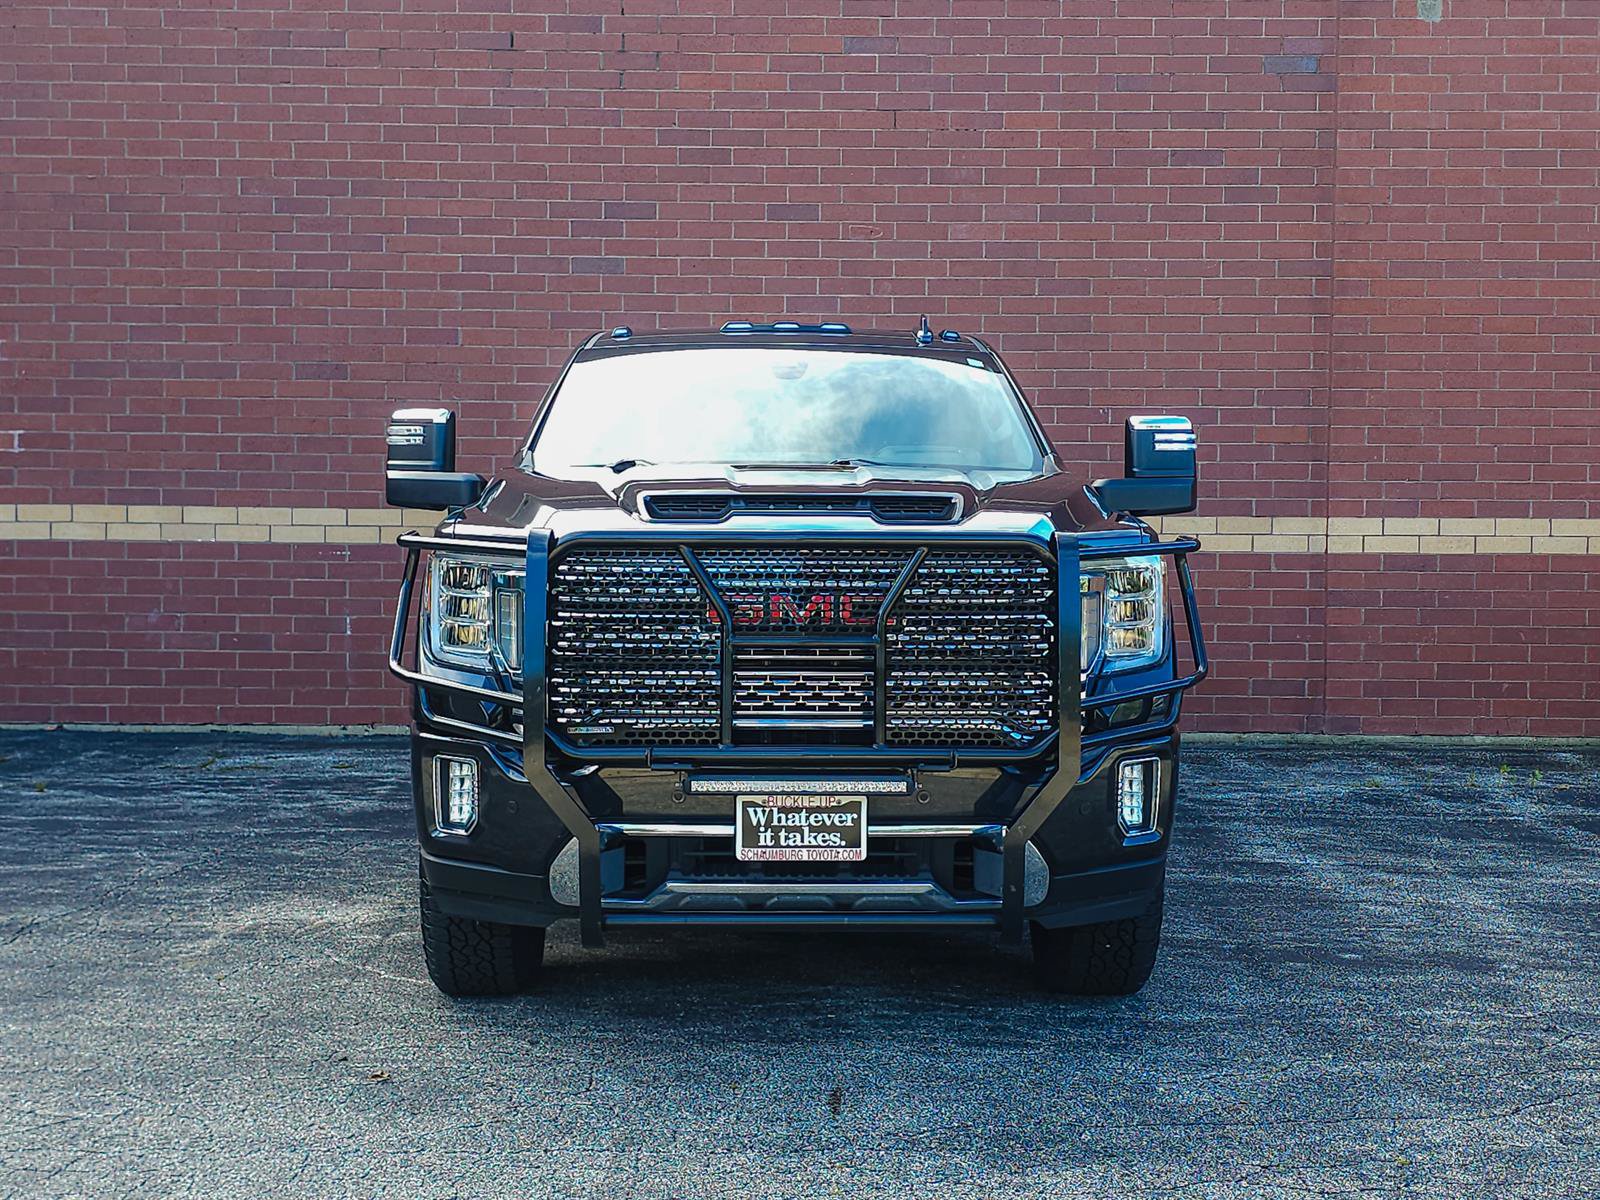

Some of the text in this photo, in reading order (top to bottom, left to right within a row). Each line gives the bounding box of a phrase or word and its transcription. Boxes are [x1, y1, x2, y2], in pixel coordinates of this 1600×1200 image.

[706, 595, 896, 625] GMC
[767, 796, 836, 808] BUCKLE UP
[746, 807, 858, 827] Whatever
[758, 826, 846, 847] it takes.
[740, 849, 862, 860] SCHAUMBURG TOYOTA.COM
